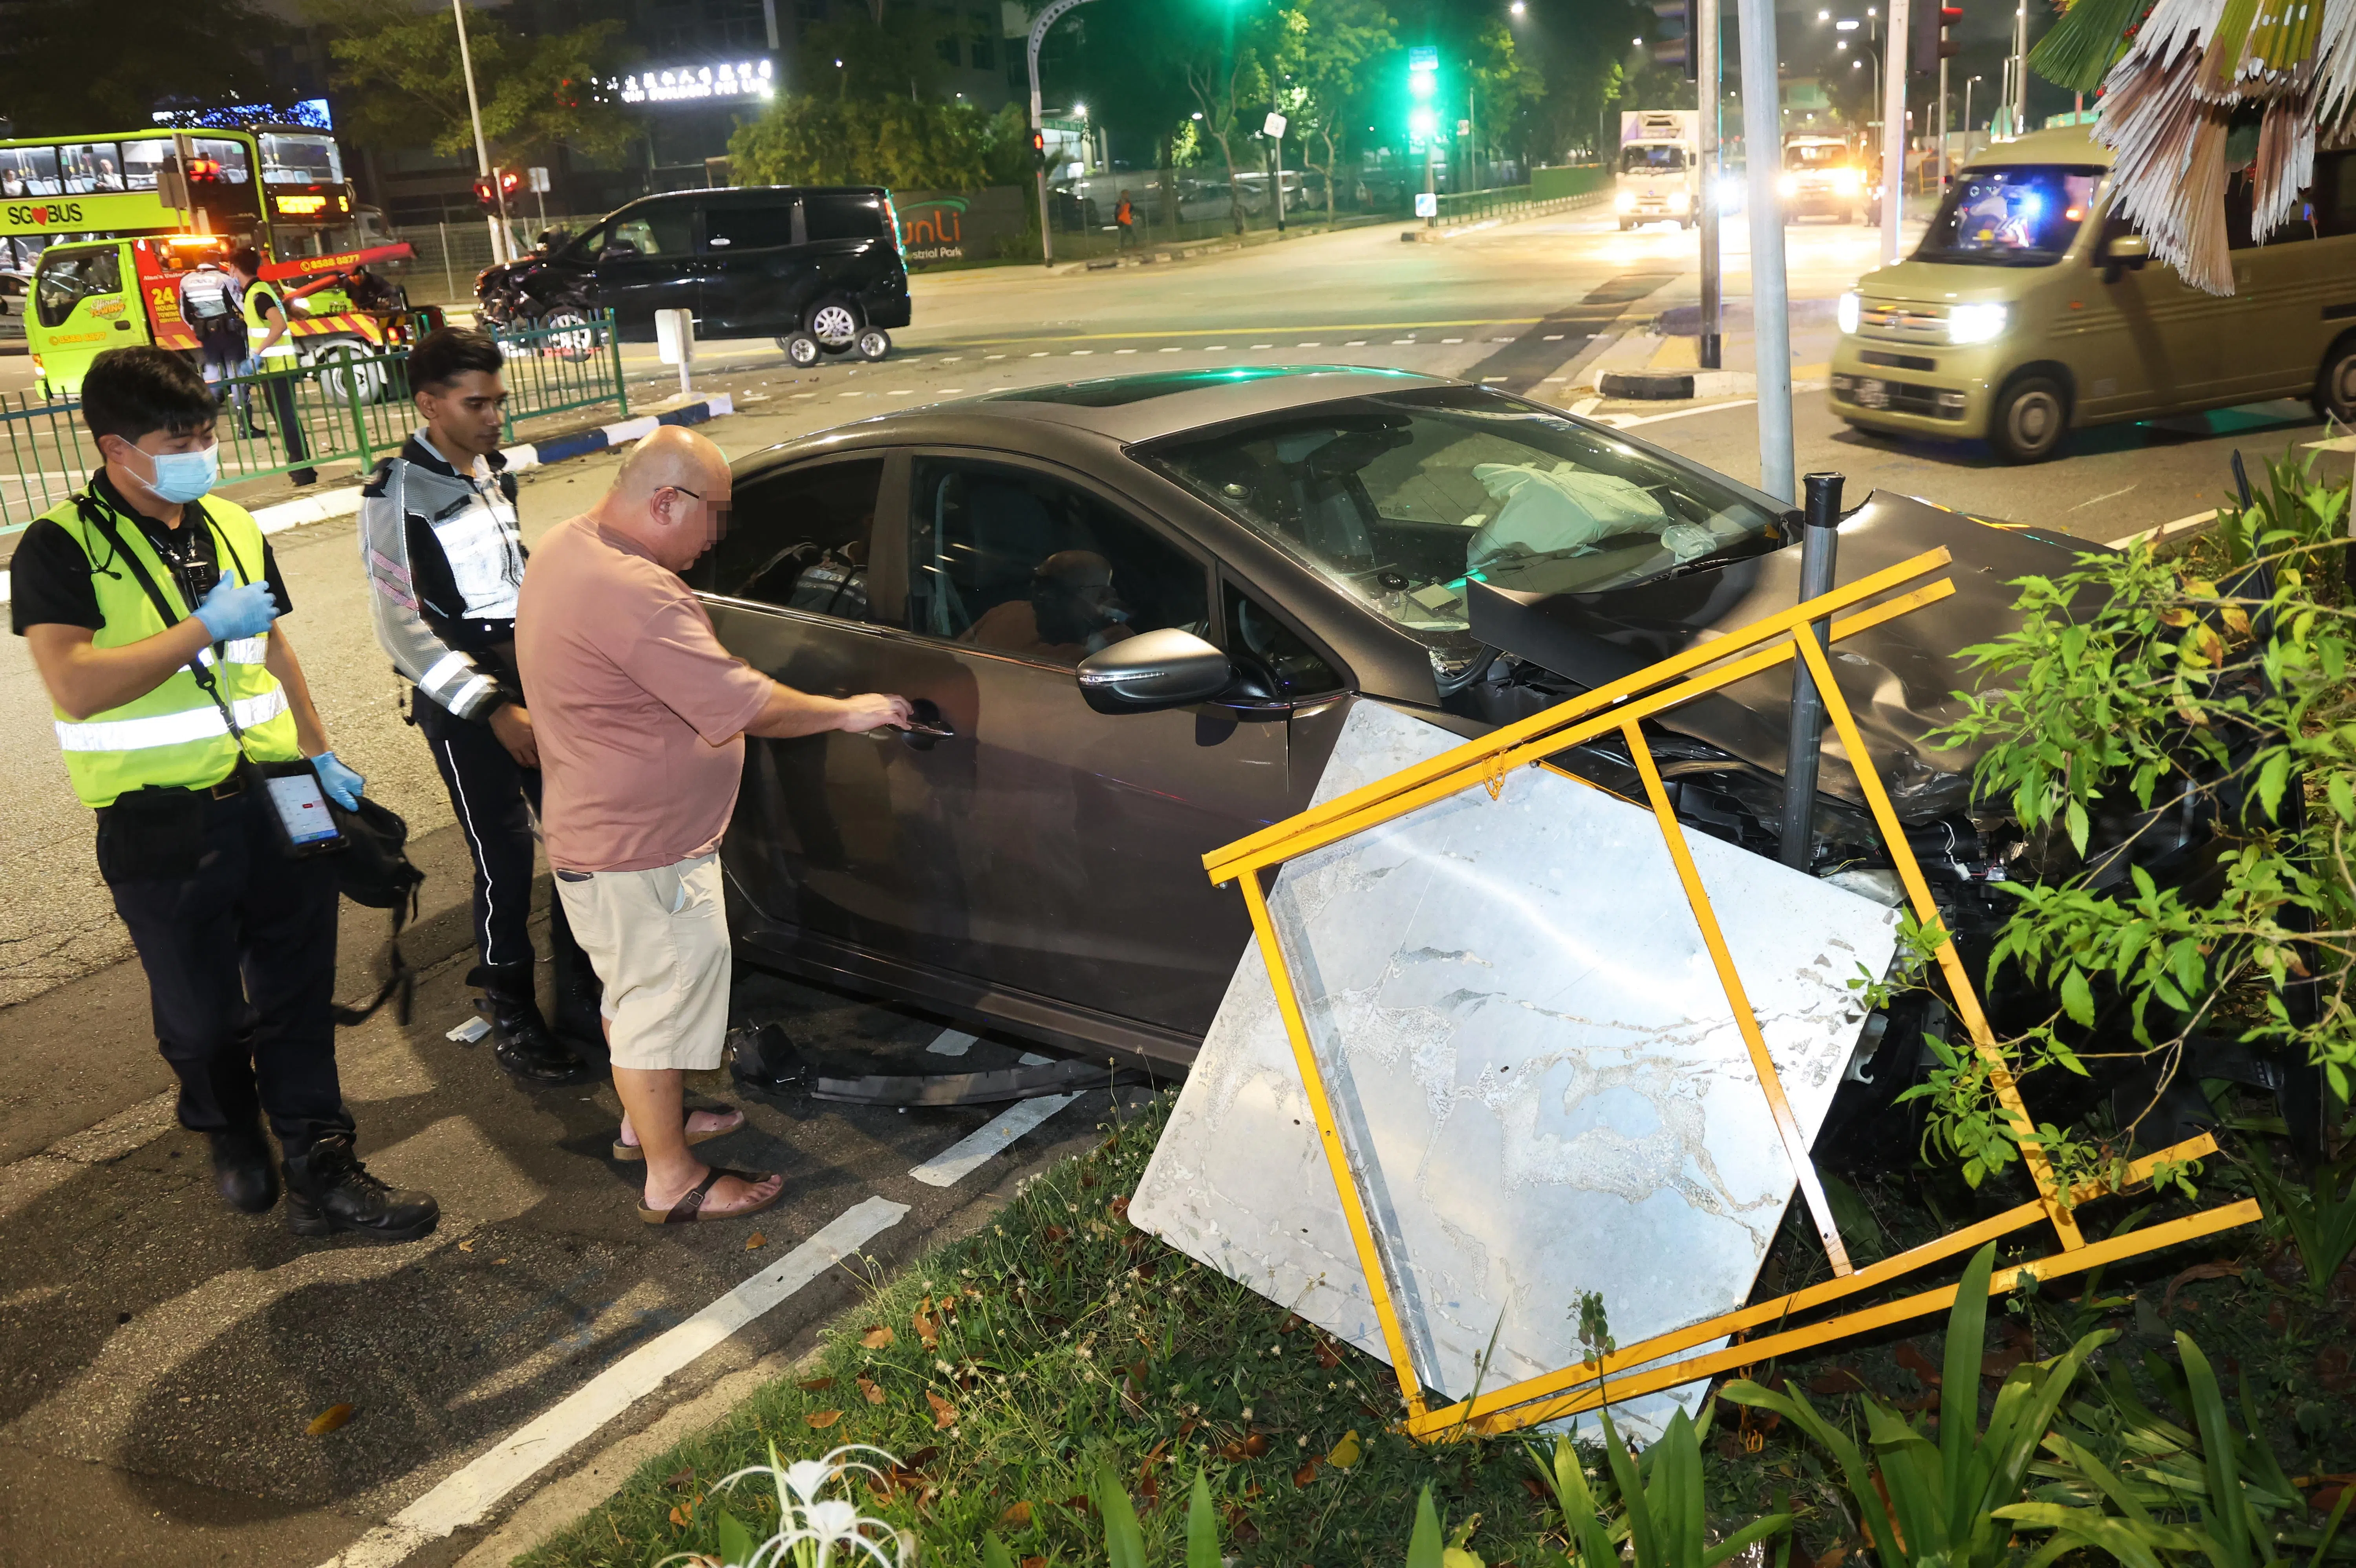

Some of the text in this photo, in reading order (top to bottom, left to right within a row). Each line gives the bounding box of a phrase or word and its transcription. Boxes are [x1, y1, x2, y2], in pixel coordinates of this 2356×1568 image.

[338, 196, 349, 212] 5
[912, 246, 962, 260] strial Park
[151, 286, 176, 305] 24
[154, 304, 177, 312] HOURS
